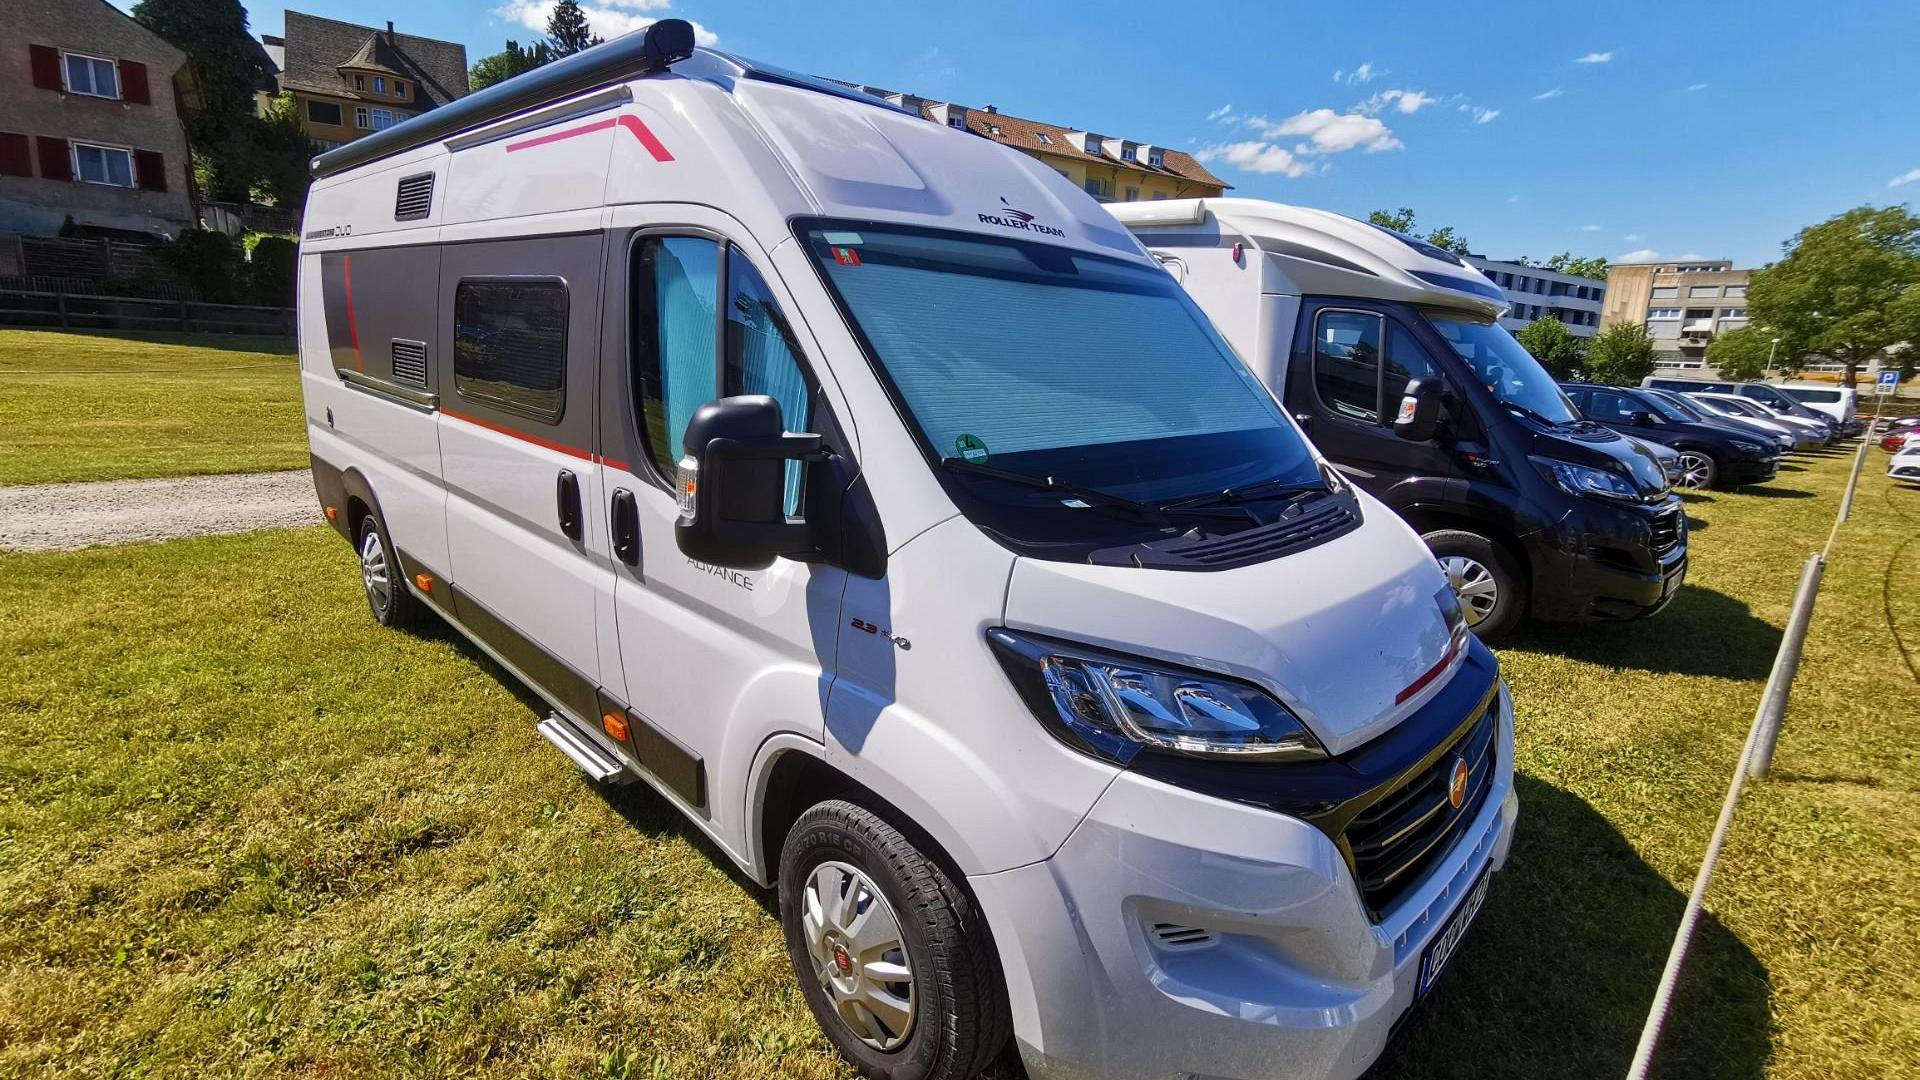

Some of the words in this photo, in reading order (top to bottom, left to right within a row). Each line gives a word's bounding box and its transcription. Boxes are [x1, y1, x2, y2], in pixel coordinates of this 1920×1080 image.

[335, 224, 352, 237] DUO
[977, 213, 1031, 231] ROLLER
[1031, 222, 1066, 238] TEAM
[1882, 373, 1894, 384] P
[964, 434, 976, 449] 4
[687, 558, 753, 592] ADVANCE
